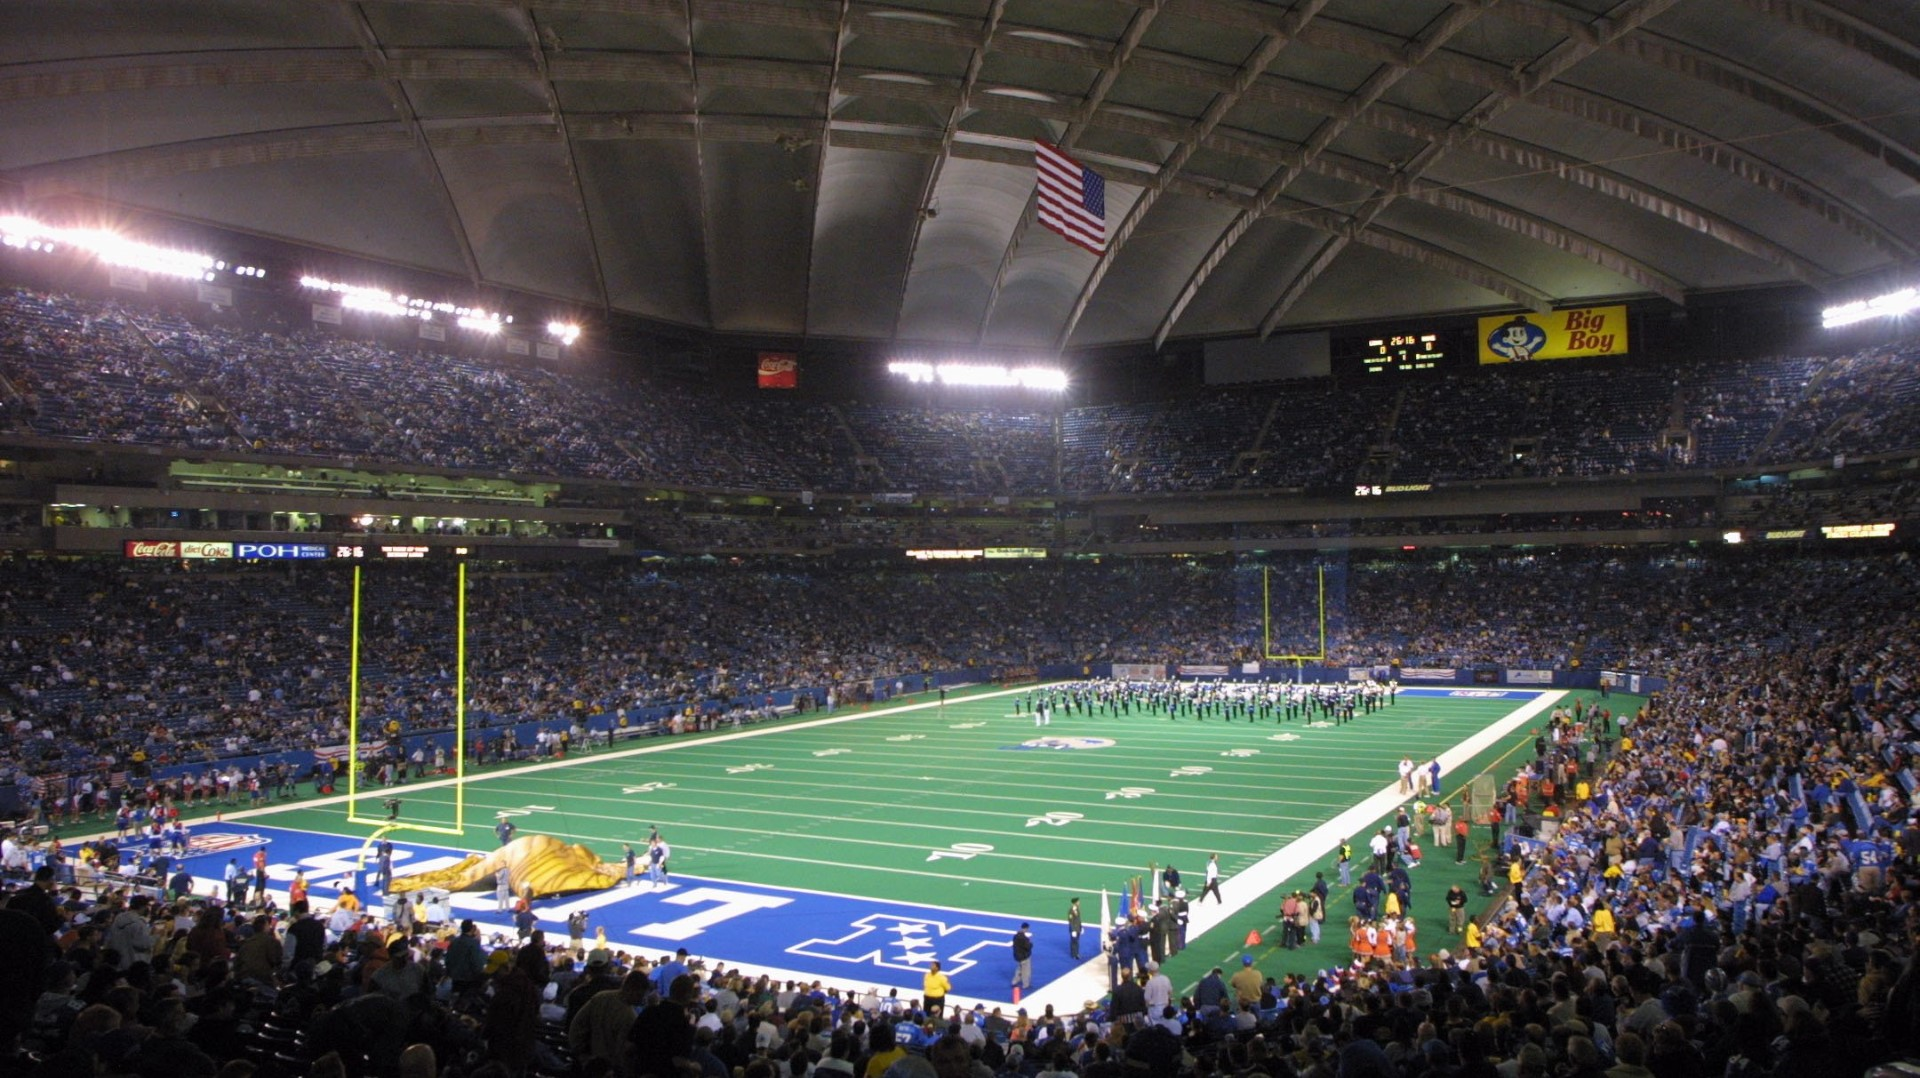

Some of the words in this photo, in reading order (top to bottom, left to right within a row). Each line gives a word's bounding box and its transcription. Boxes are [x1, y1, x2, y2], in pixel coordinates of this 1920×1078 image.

[1565, 310, 1606, 334] Big
[1567, 330, 1615, 353] Boy
[184, 544, 201, 554] diet
[201, 543, 230, 557] Coke
[239, 544, 298, 558] POH
[1025, 811, 1085, 828] 20
[926, 842, 995, 862] 10
